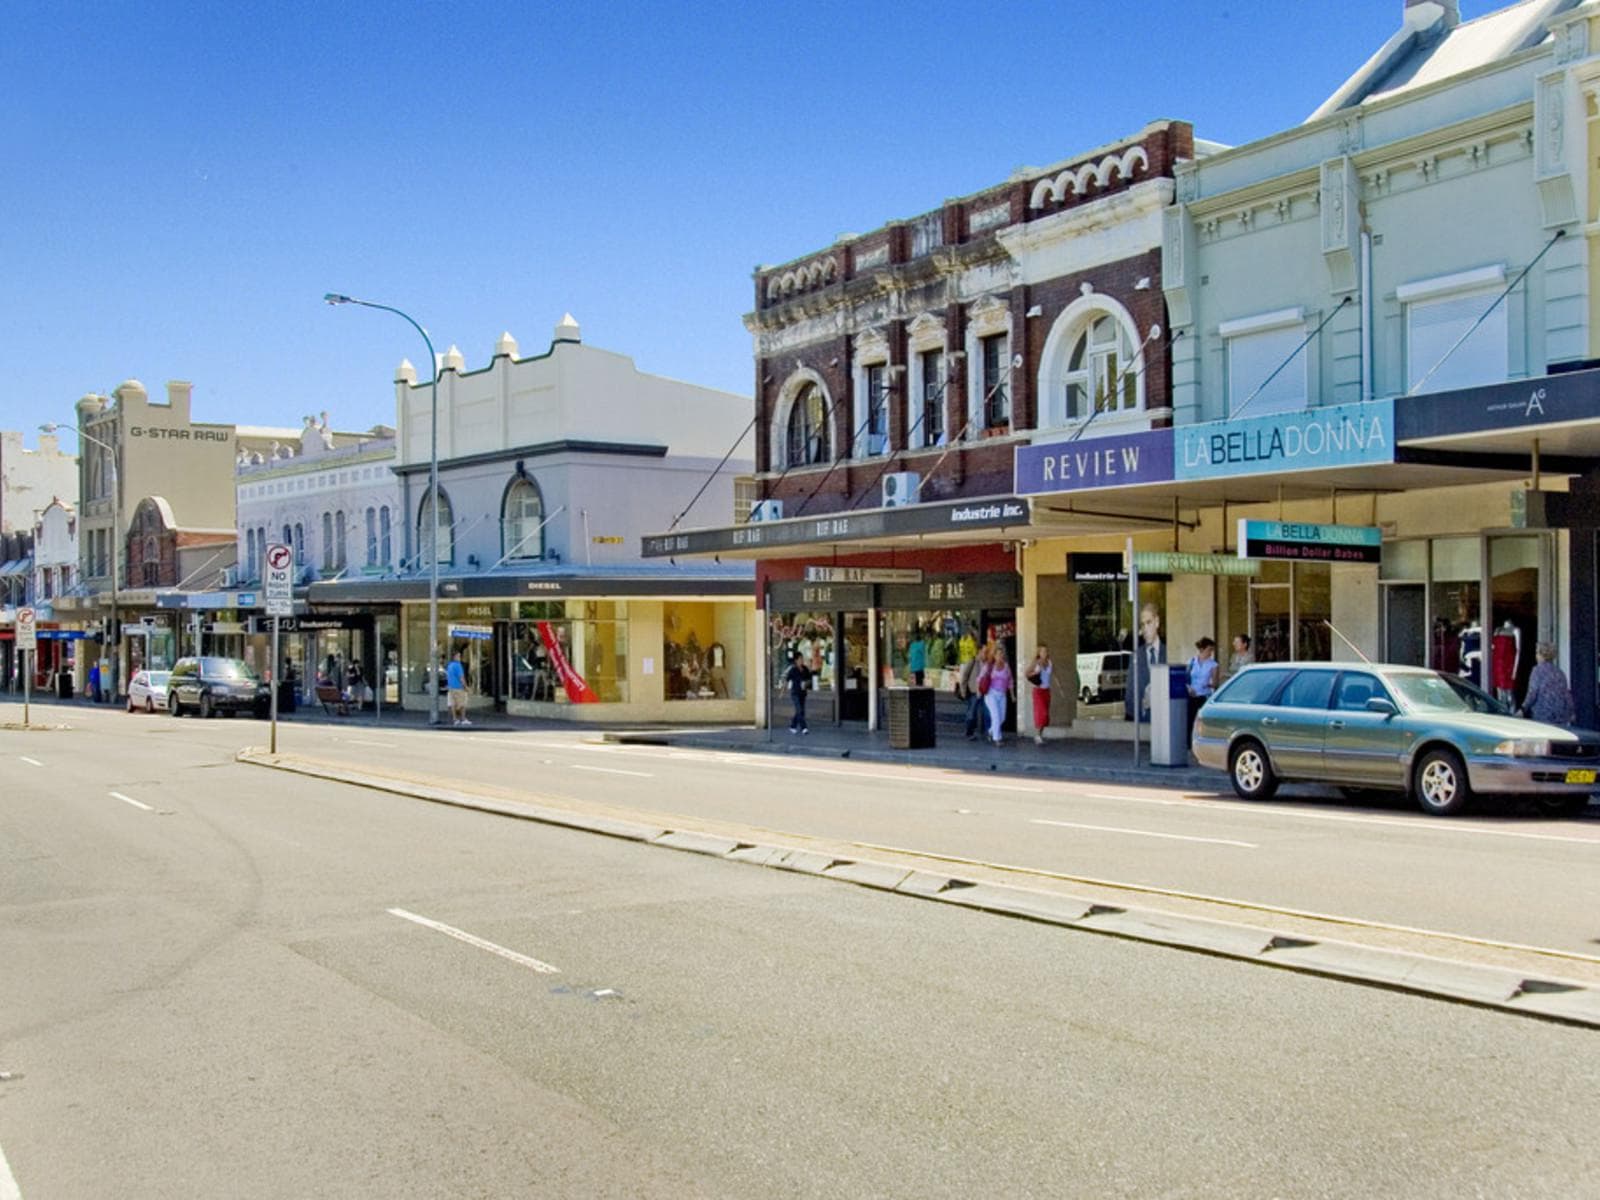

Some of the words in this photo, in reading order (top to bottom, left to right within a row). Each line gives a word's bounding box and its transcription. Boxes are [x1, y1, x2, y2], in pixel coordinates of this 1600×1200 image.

[130, 427, 190, 440] G-STAR
[194, 431, 229, 442] RAW
[1043, 446, 1140, 481] REVIEW
[1265, 544, 1299, 556] Billion
[1301, 547, 1332, 558] Dollar
[1334, 548, 1364, 560] Babes
[1168, 555, 1225, 573] REVIEW
[271, 572, 286, 581] NO
[527, 581, 562, 590] DIESEL
